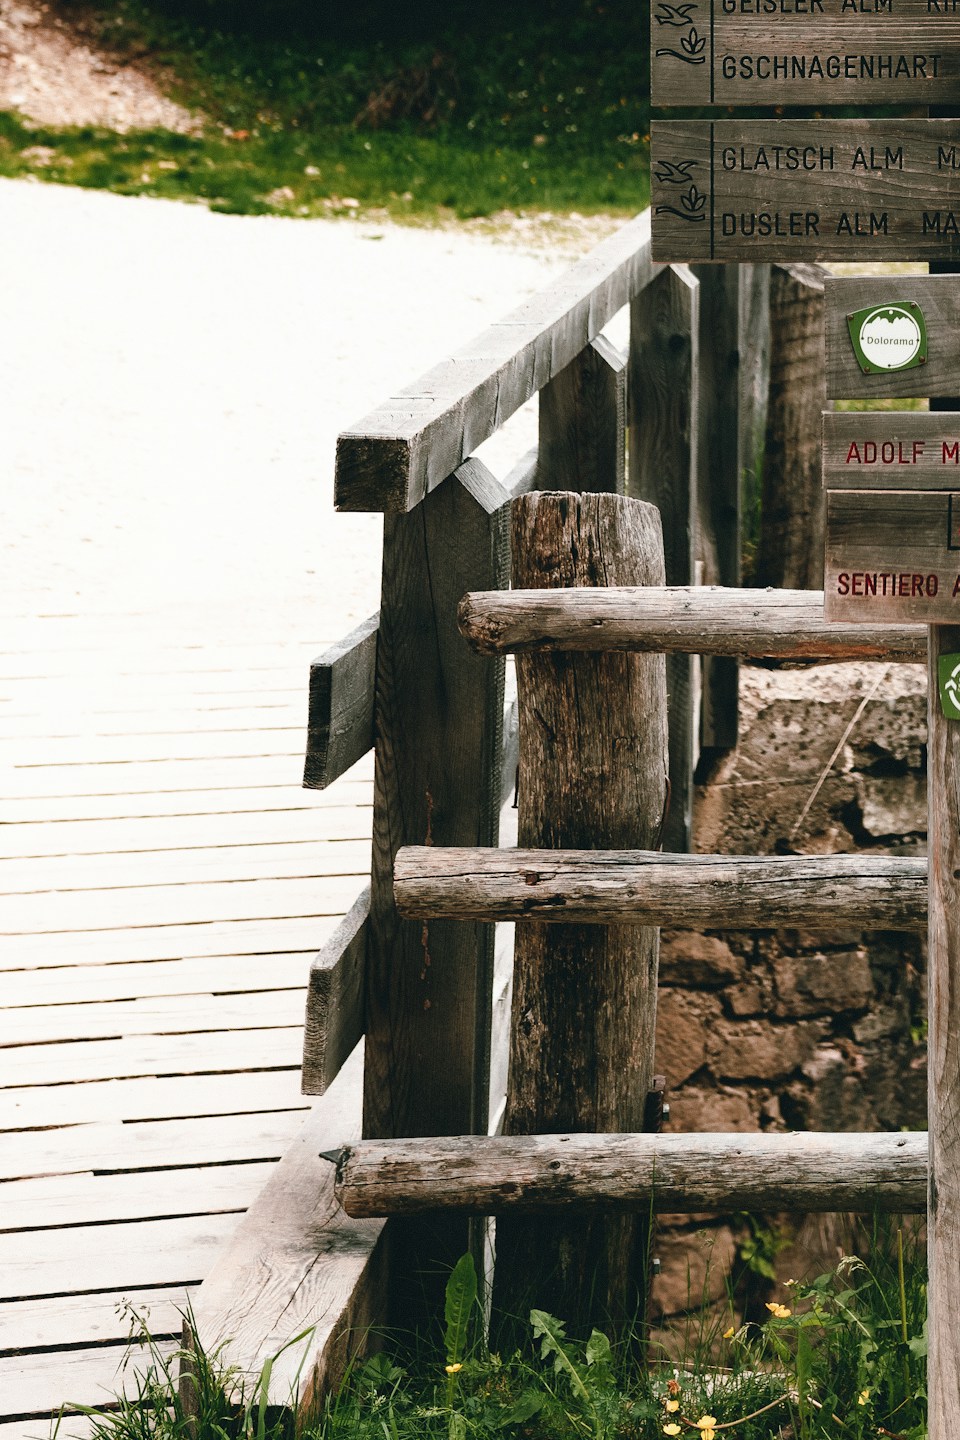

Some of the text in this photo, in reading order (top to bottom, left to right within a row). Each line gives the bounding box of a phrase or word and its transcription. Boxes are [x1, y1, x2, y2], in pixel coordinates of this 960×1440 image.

[722, 55, 942, 79] GSCHNAGENHART
[721, 146, 834, 171] GLATSCH
[851, 146, 904, 171] ALM
[721, 212, 820, 237] DUSLER
[836, 212, 889, 237] ALM
[866, 336, 914, 346] Dolorama
[845, 440, 926, 464] ADOLF
[837, 573, 939, 597] SENTIERO
